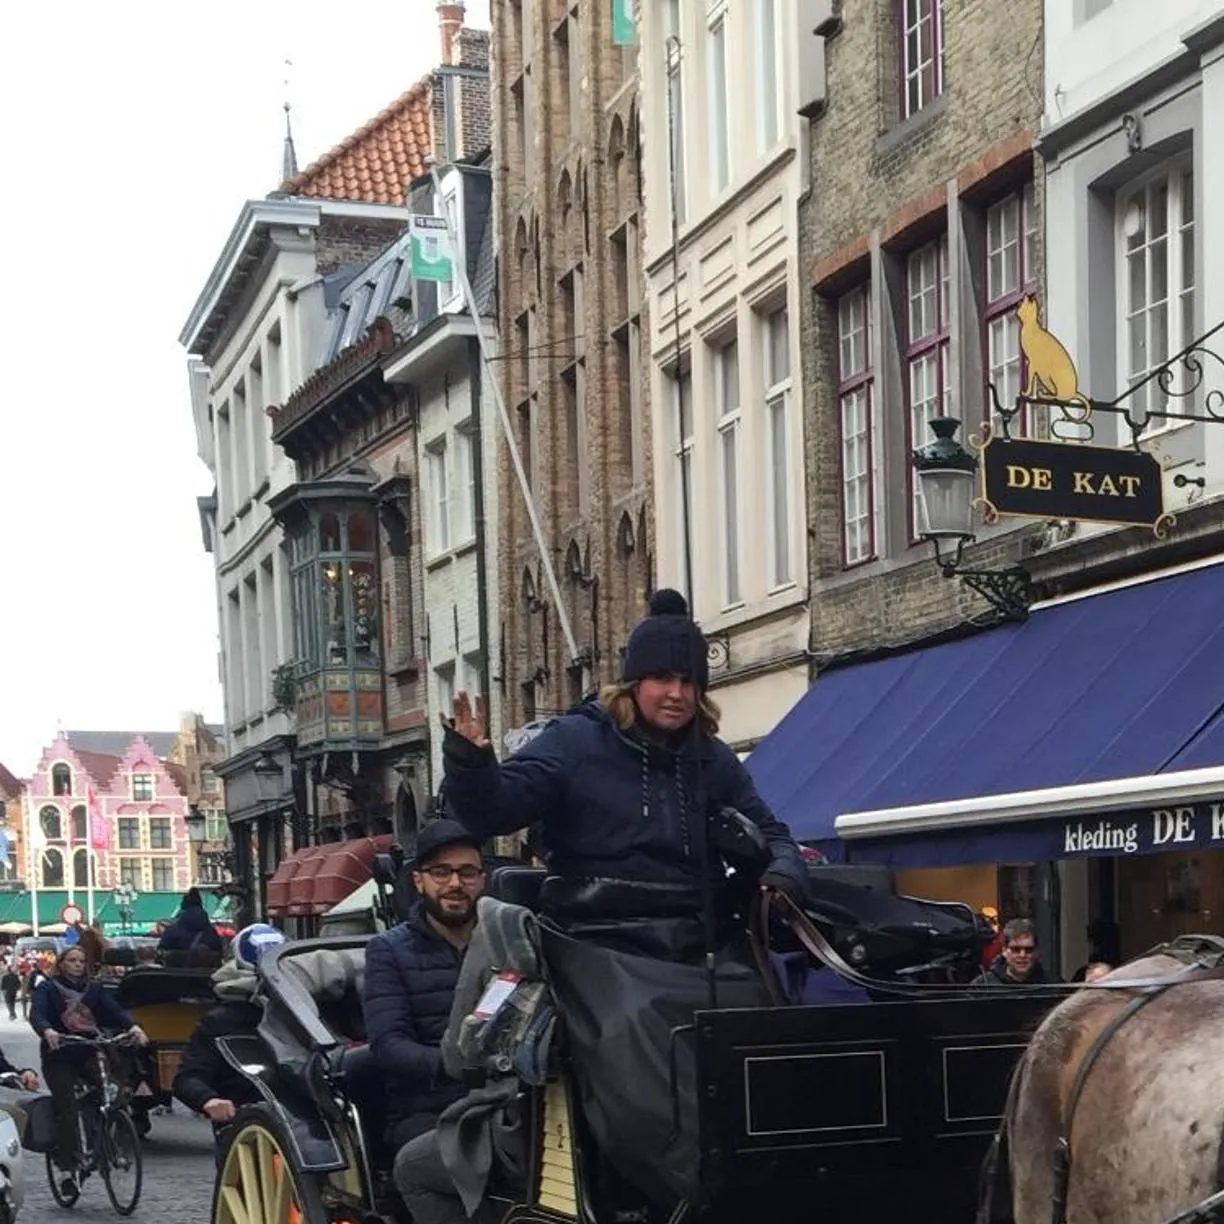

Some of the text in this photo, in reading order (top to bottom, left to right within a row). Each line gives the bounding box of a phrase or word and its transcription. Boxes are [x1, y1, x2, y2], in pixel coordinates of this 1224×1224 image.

[1006, 465, 1141, 497] DE KAT
[1065, 822, 1138, 852] kleding
[1152, 807, 1196, 845] DE
